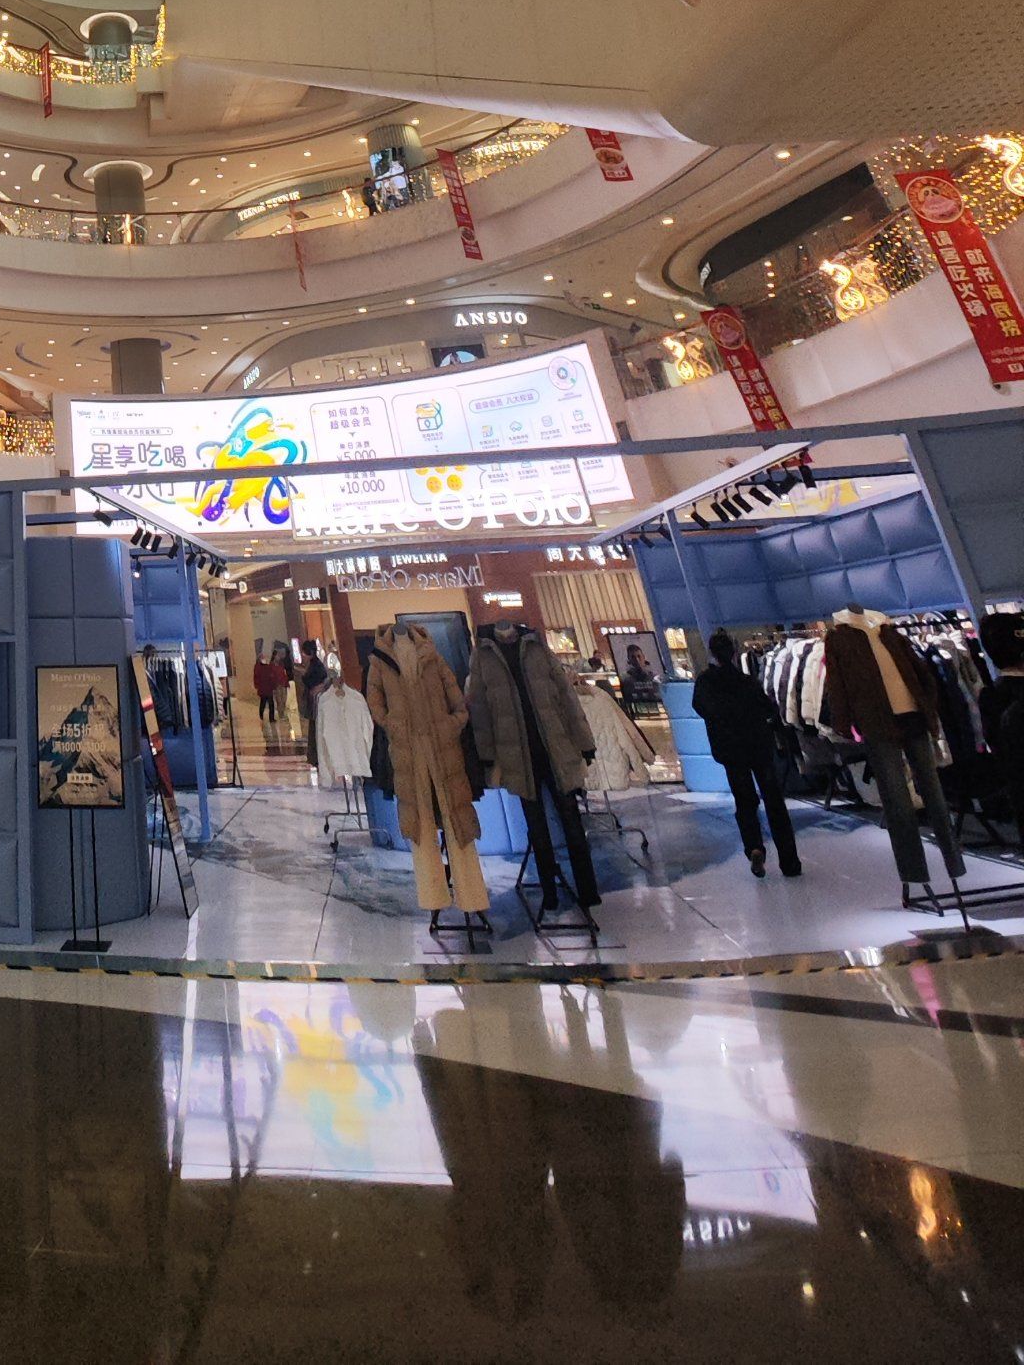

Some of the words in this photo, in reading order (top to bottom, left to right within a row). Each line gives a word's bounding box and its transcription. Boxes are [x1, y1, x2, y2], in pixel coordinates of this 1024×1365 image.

[455, 311, 528, 327] ANSUO
[330, 417, 372, 430] 超级会员
[83, 440, 187, 472] 星享吃喝
[337, 449, 377, 462] ¥5000
